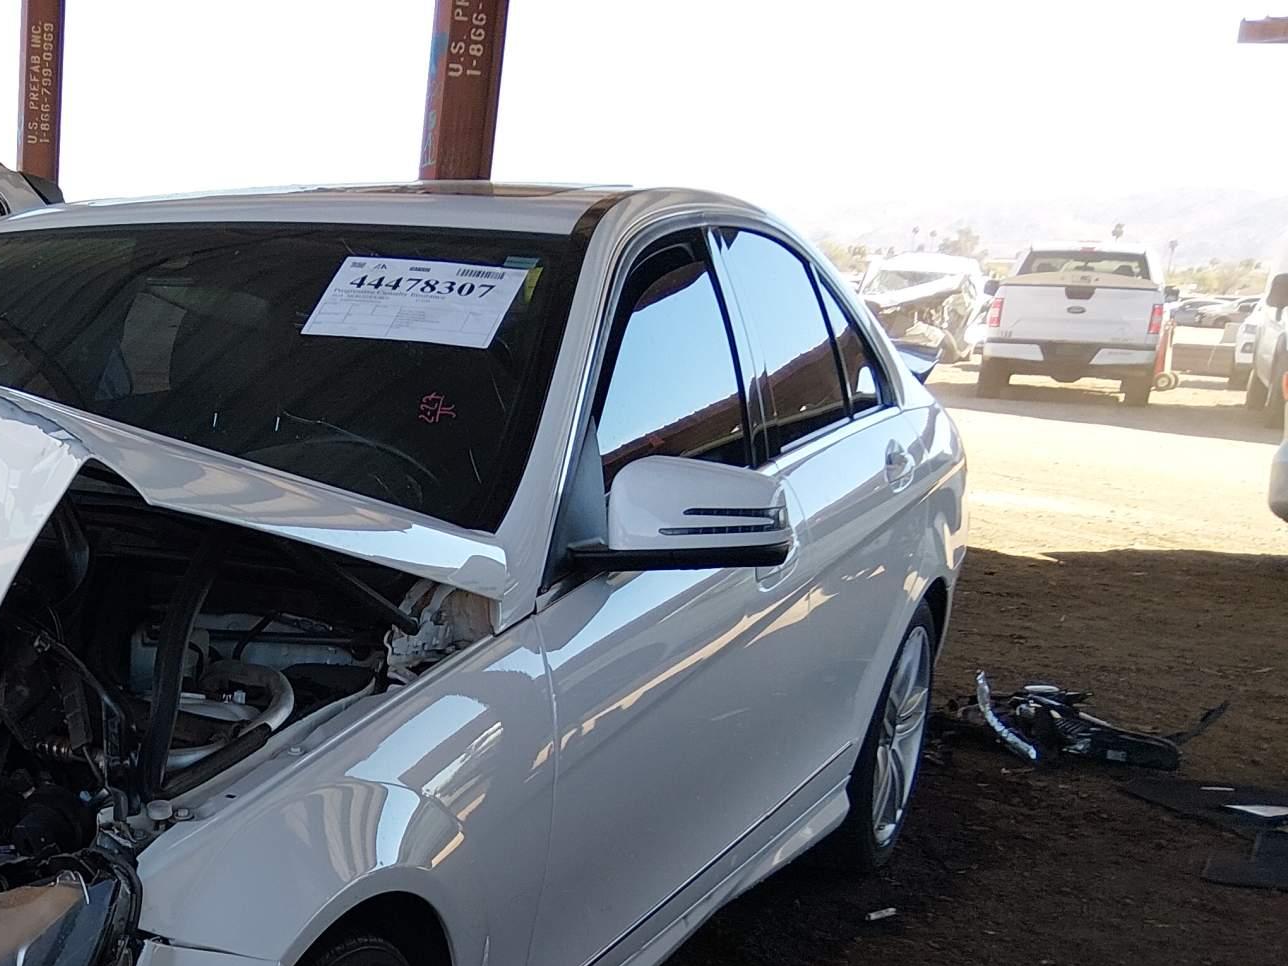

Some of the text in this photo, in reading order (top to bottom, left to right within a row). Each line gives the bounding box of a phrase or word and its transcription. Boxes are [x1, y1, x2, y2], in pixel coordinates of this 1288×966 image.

[447, 34, 466, 77] U.S.
[27, 21, 43, 144] U.S. PREFAB INC.
[349, 274, 496, 298] 44478307
